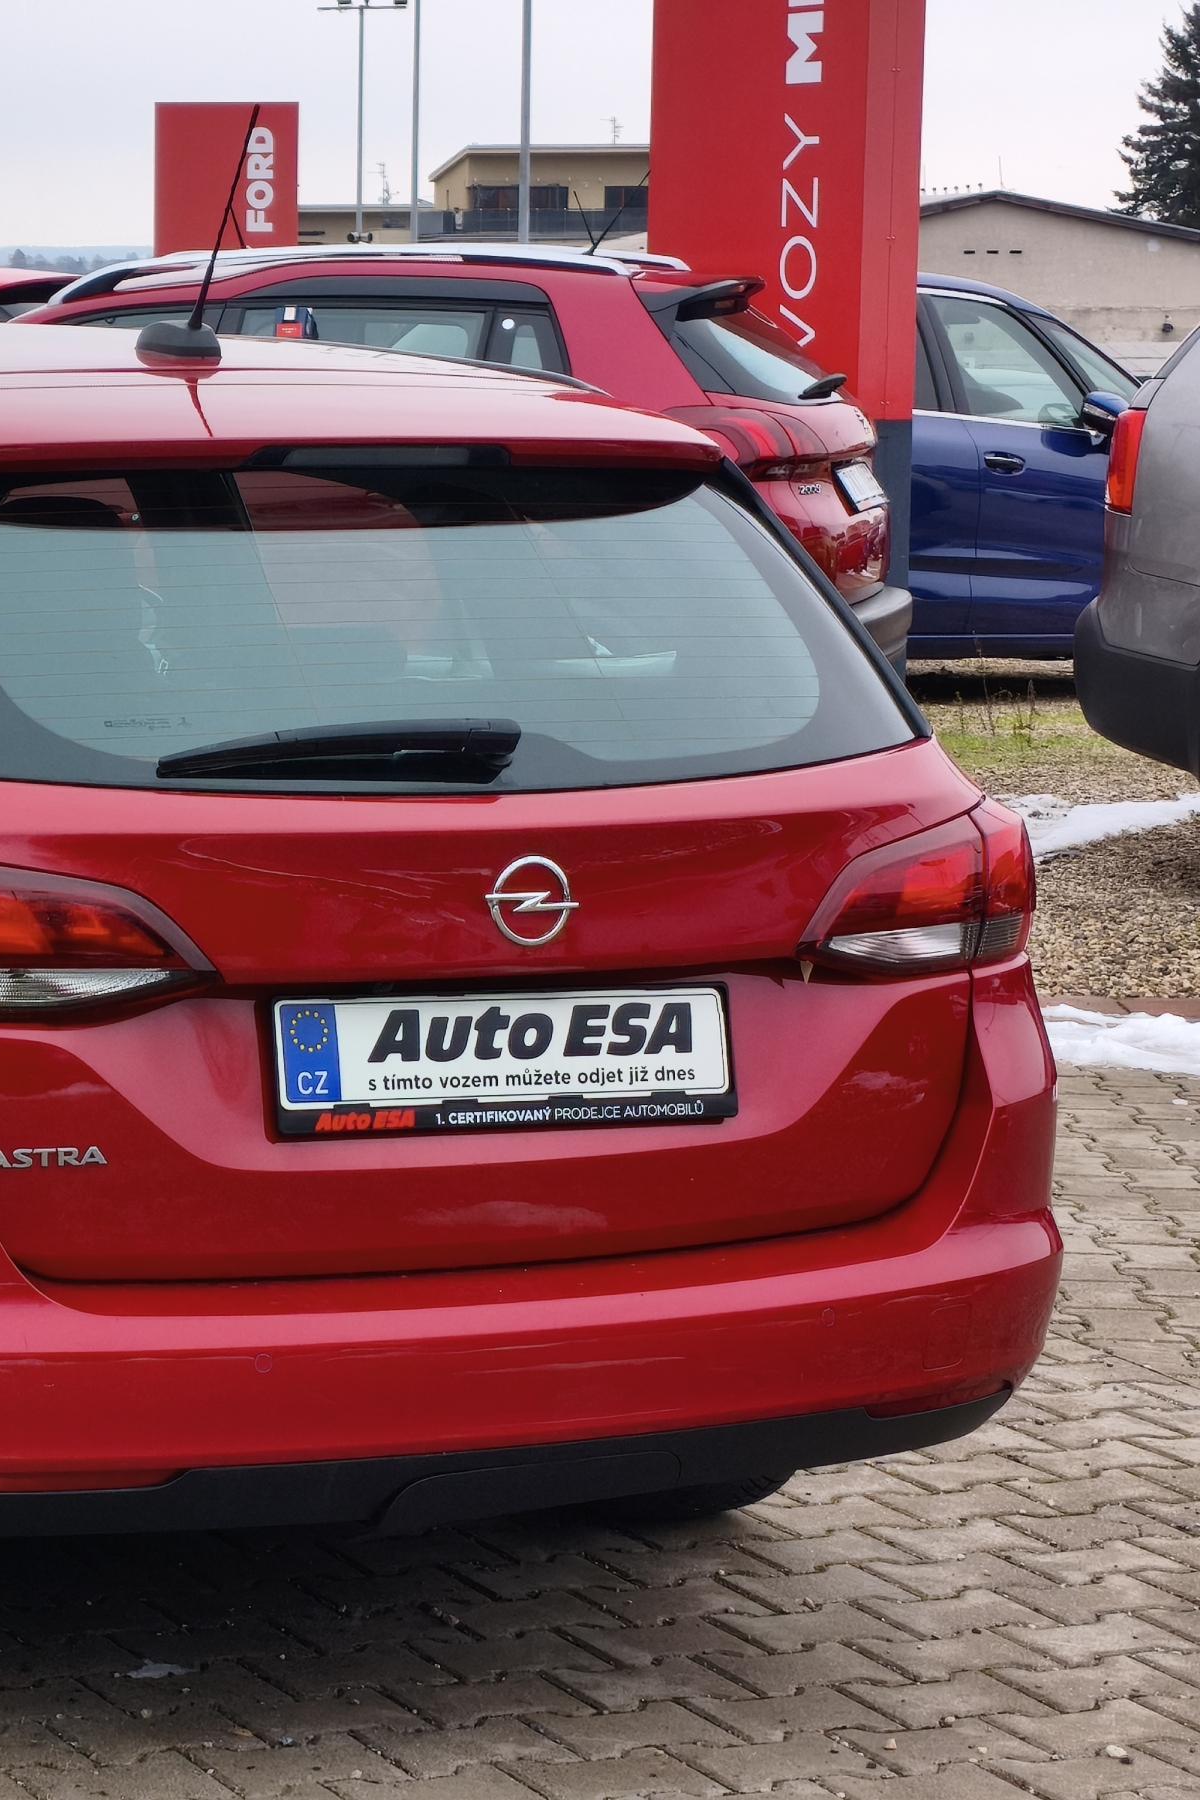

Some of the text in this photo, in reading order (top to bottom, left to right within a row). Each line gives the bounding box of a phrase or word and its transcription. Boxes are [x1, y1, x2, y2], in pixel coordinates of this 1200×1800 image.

[246, 127, 274, 232] FORD
[779, 113, 820, 347] VOZY
[366, 1002, 693, 1063] Auto ESA
[297, 1070, 329, 1096] CZ
[368, 1065, 696, 1091] s tímto vozem můžete odjet již dnes
[315, 1109, 416, 1132] Auto ESA
[435, 1100, 704, 1125] 1. CERTIFIKOVANÝ PRODEJCE AUTOMOBILŮ
